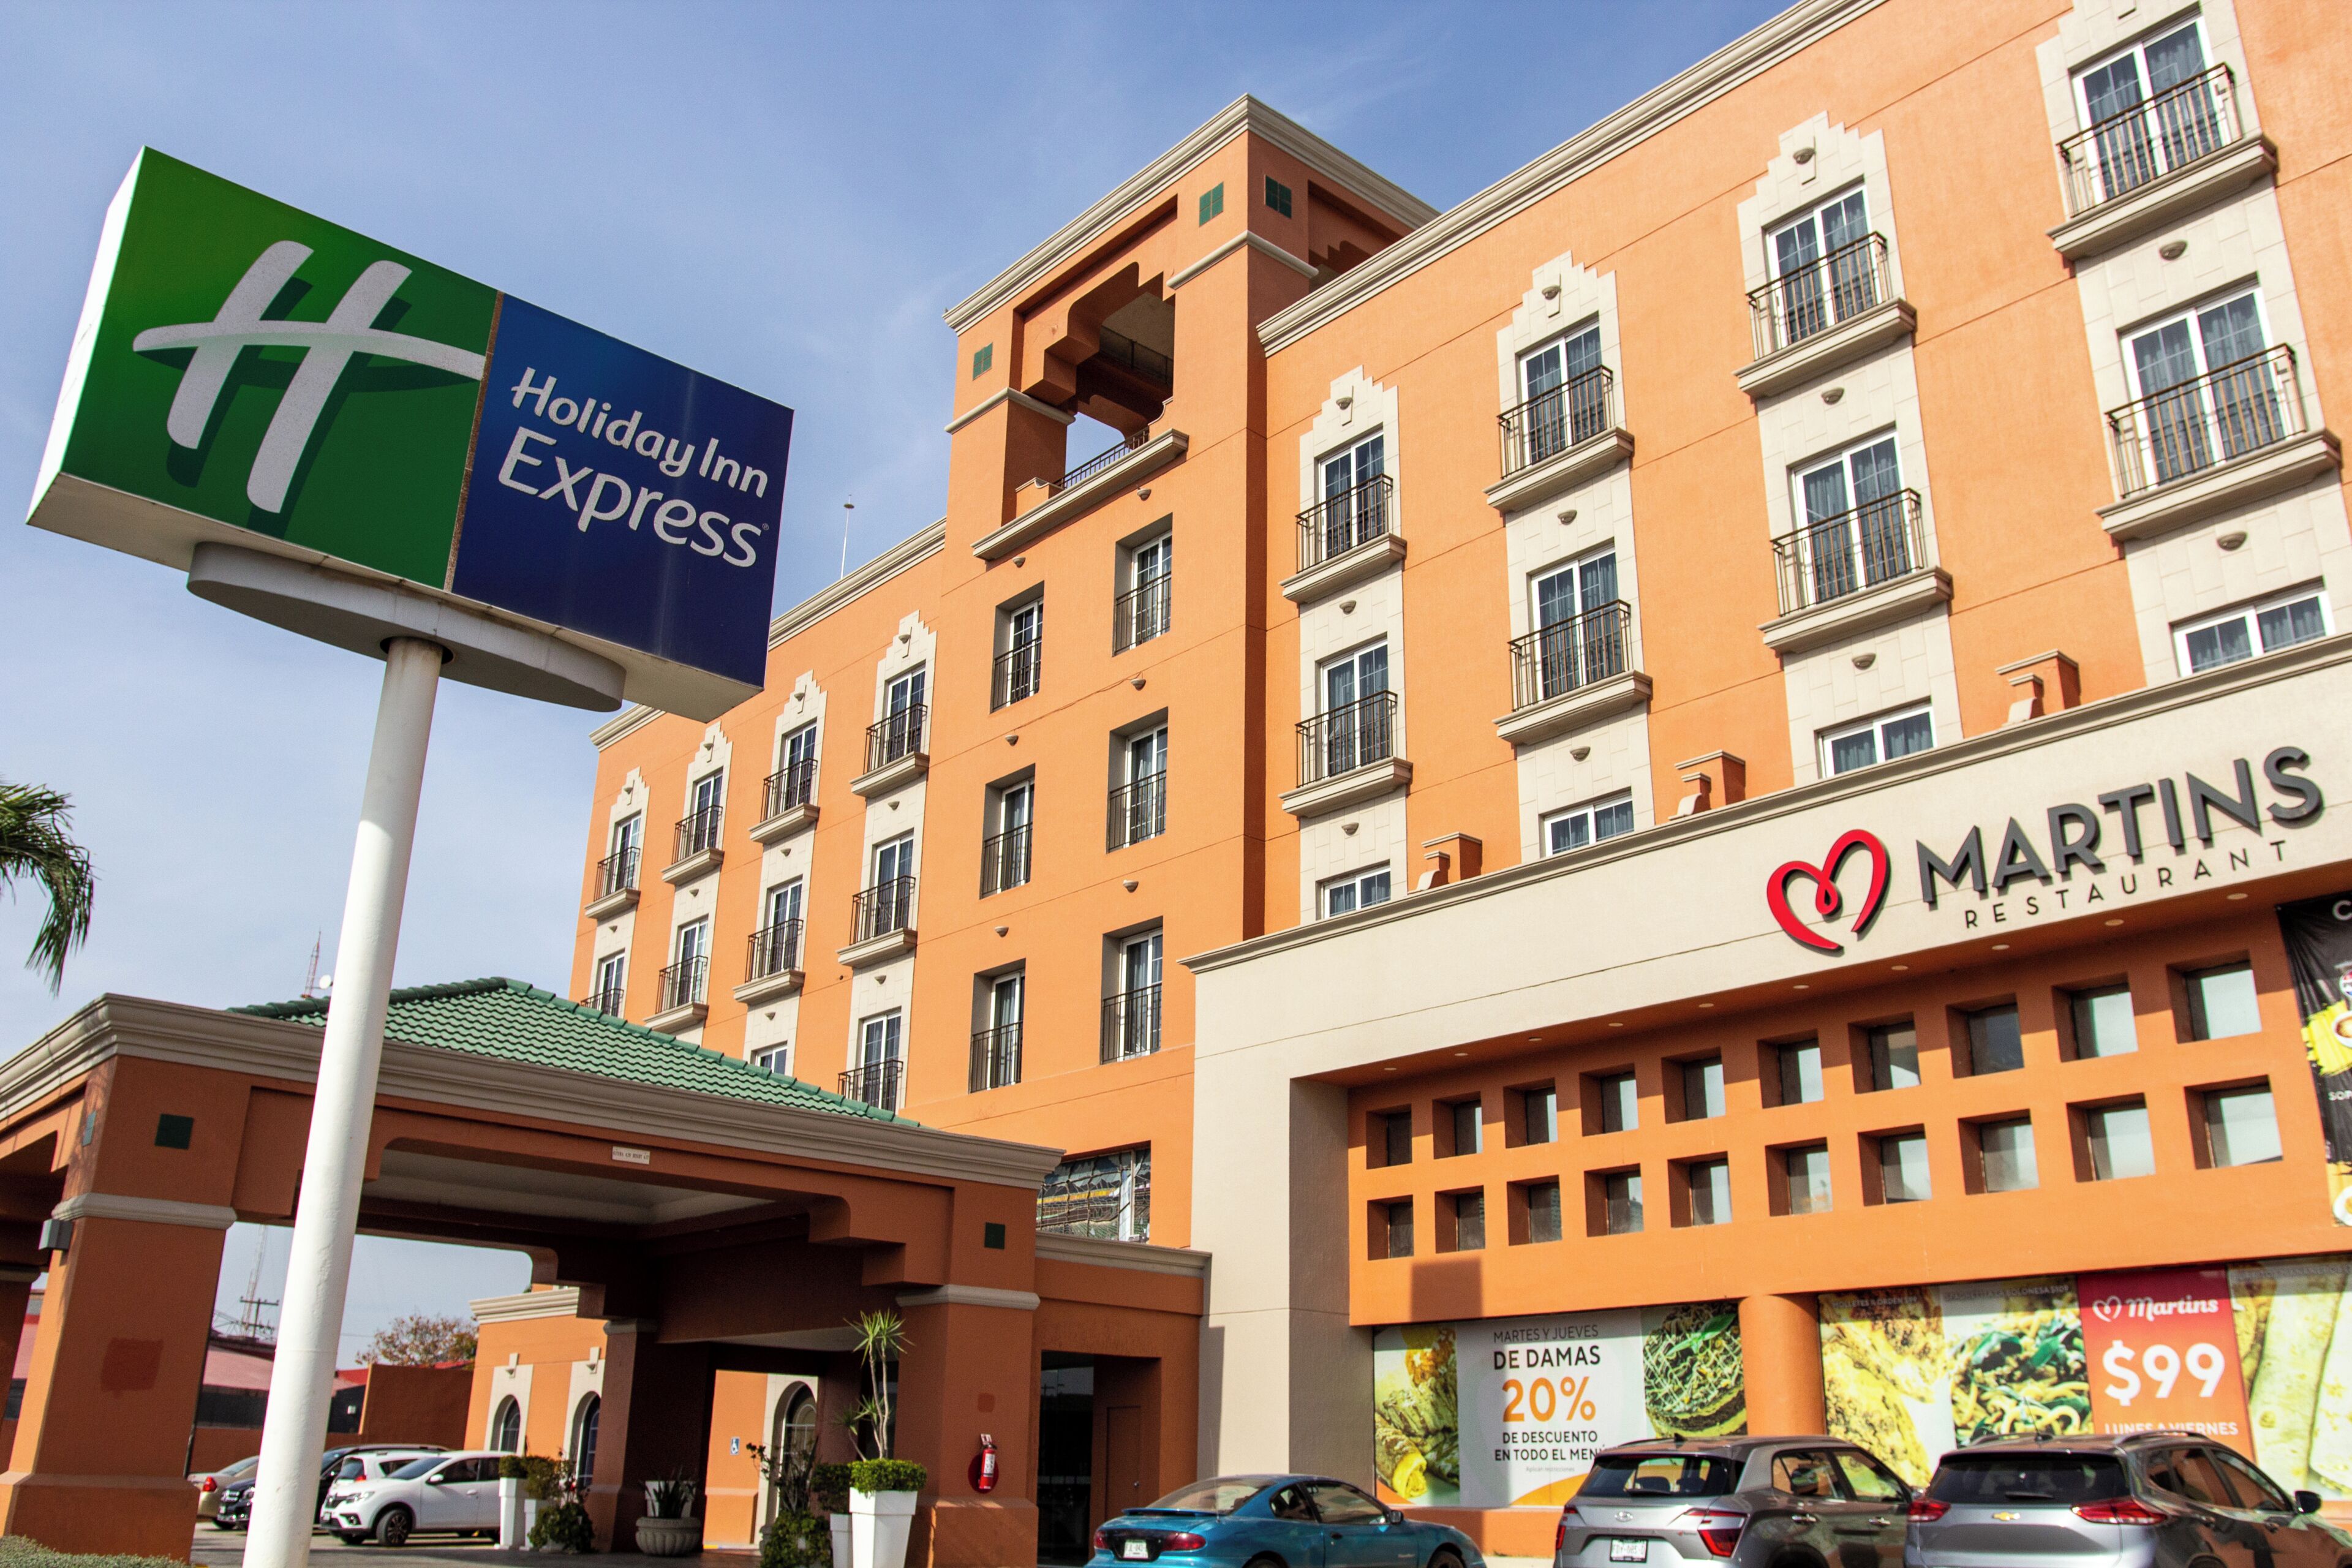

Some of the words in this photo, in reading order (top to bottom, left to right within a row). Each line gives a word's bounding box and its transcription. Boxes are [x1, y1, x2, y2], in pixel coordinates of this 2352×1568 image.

[511, 367, 695, 477] Holiday
[699, 437, 769, 498] Inn
[498, 426, 761, 567] Express
[1916, 746, 2326, 905] MARTINS
[1965, 840, 2288, 929] RESTAURANT
[2125, 1295, 2218, 1322] Martins
[1493, 1328, 1540, 1343] MARTES
[1542, 1328, 1550, 1340] Y
[1553, 1324, 1599, 1340] JUEVES
[1493, 1350, 1520, 1370] DE
[1526, 1345, 1601, 1368] DAMAS
[2102, 1340, 2225, 1407] $99
[1502, 1376, 1597, 1422] 20%
[1502, 1432, 1518, 1444] DE
[1522, 1430, 1598, 1443] DESCUENTO
[2168, 1422, 2239, 1436] VIERNES
[1494, 1449, 1511, 1461] EN
[1513, 1449, 1548, 1461] TODO
[1552, 1449, 1566, 1461] EL
[1570, 1444, 1605, 1460] MEN
